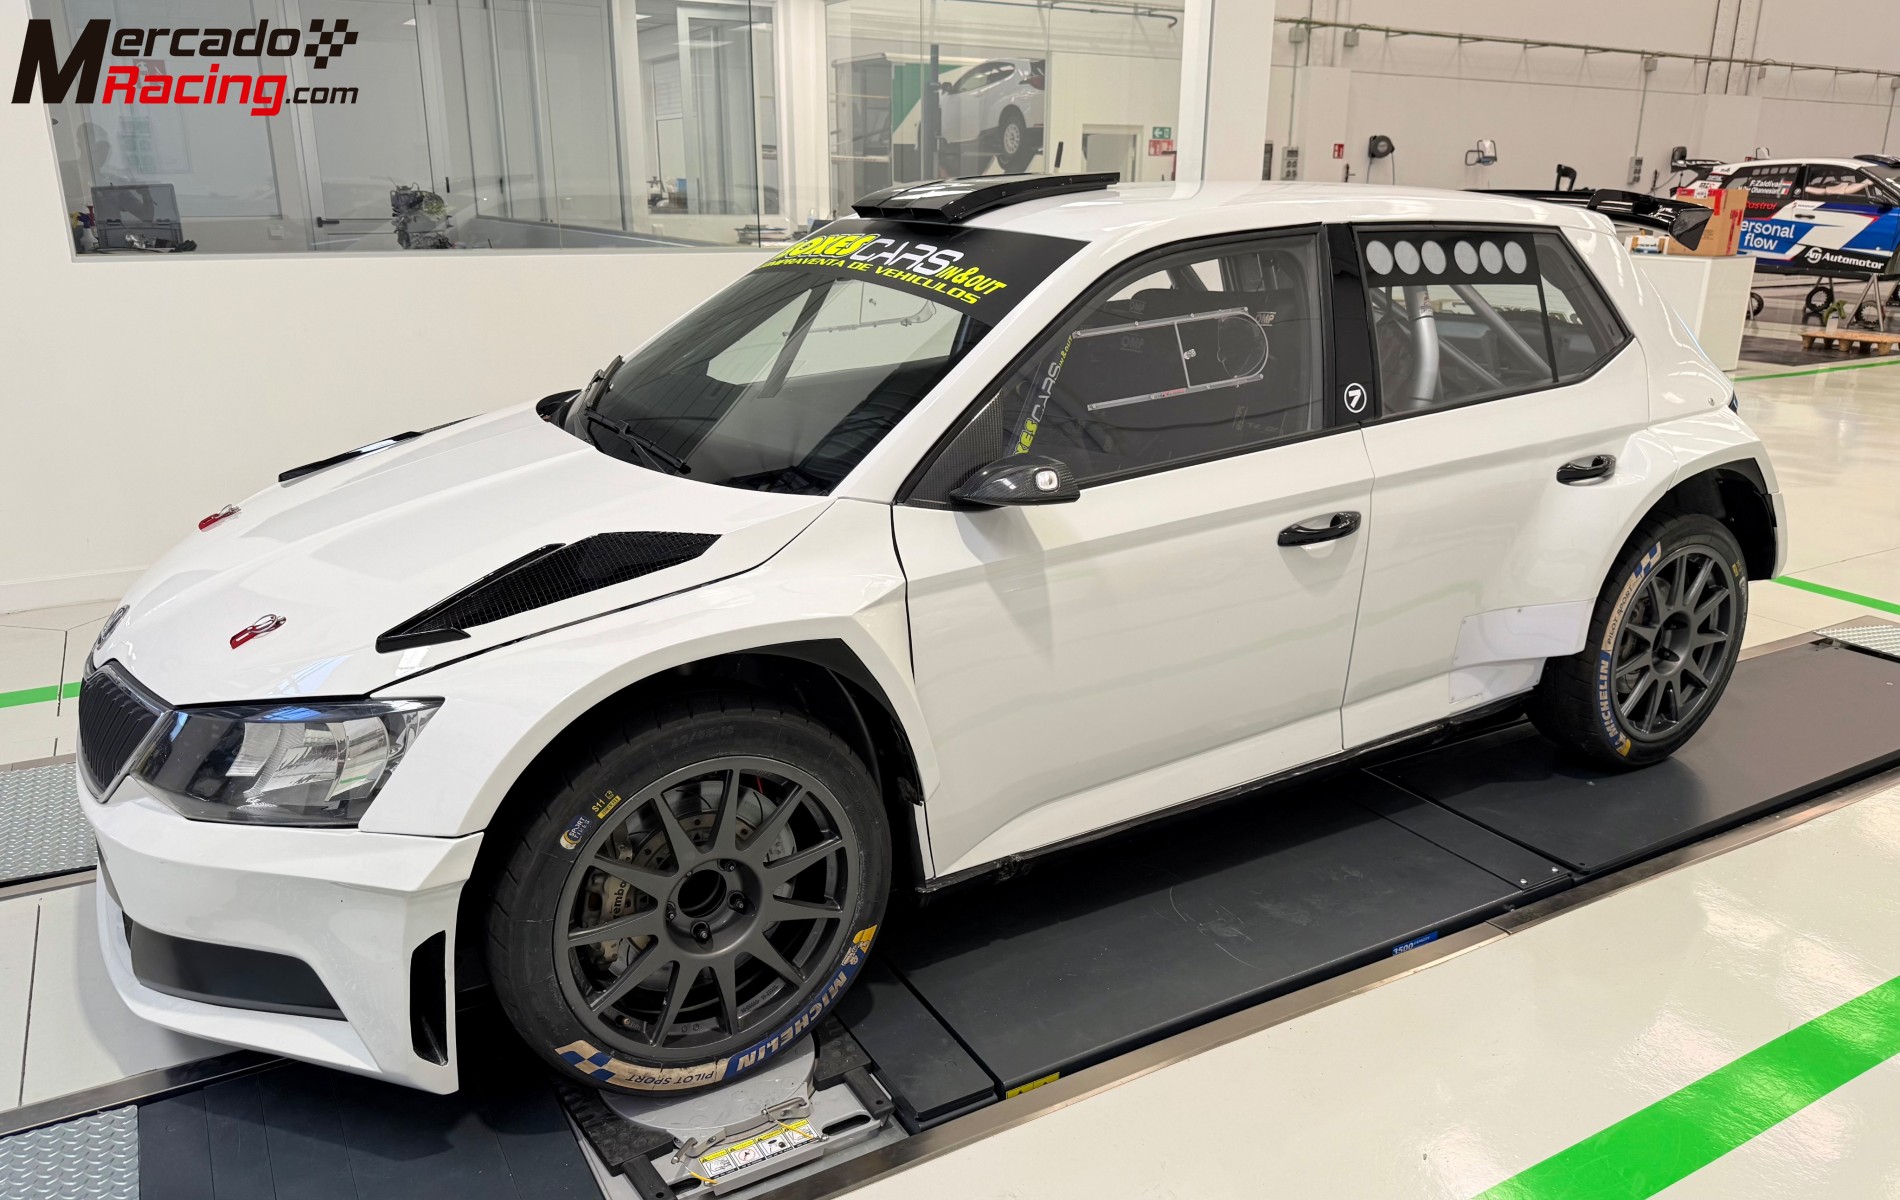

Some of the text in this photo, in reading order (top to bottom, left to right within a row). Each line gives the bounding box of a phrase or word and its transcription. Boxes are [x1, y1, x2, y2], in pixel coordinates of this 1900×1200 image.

[1741, 220, 1795, 239] ersonal
[1744, 233, 1778, 251] flow
[774, 234, 881, 259] OXES
[1822, 252, 1884, 270] Automotor
[847, 261, 873, 272] DE
[875, 266, 981, 305] VEHICULOS
[1607, 586, 1634, 645] PILOT SPORT
[1599, 659, 1619, 738] MICHELIN
[613, 881, 627, 920] rembo
[736, 970, 848, 1073] MICHELIN
[625, 1070, 716, 1087] PILOT SPORT
